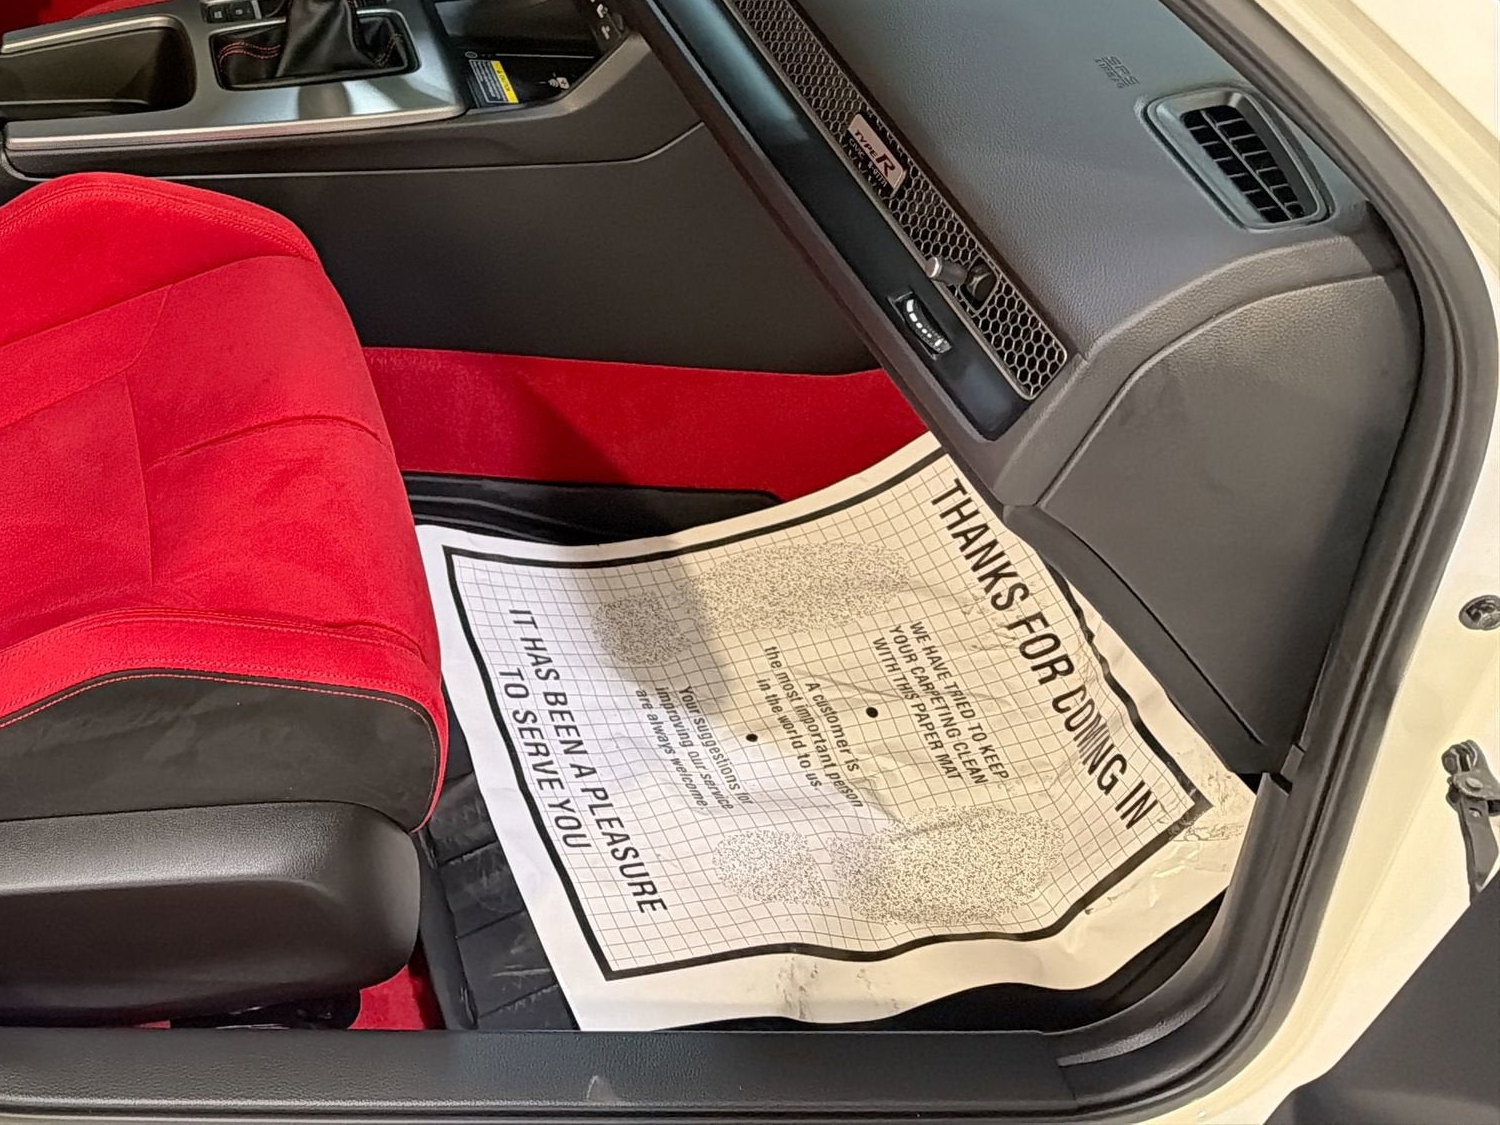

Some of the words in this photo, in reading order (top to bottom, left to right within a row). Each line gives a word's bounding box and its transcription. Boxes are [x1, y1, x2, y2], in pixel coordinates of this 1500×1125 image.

[849, 138, 866, 160] CIVIC
[854, 129, 877, 158] TYPE
[875, 153, 895, 178] R
[509, 609, 538, 629] IT
[498, 668, 529, 699] TO
[520, 637, 560, 681] HAS
[931, 478, 1030, 611] THANKS
[1005, 611, 1075, 685] FOR
[1052, 684, 1127, 796] COMING
[1115, 780, 1158, 830] IN
[805, 682, 821, 692] A
[872, 637, 900, 673] WITH
[893, 674, 920, 701] THIS
[911, 702, 944, 750] PAPER
[935, 753, 963, 780] MAT
[889, 625, 918, 664] YOUR
[910, 666, 961, 739] CARPETING
[952, 742, 988, 784] CLEAN
[910, 621, 931, 643] WE
[922, 645, 952, 681] HAVE
[944, 681, 976, 719] TRIED
[967, 722, 988, 742] TO
[978, 744, 1009, 780] KEEP
[512, 709, 565, 790] SERVE
[543, 691, 587, 755] BEEN
[635, 689, 653, 710] are
[647, 713, 676, 755] always
[655, 686, 694, 748] improving
[687, 751, 709, 771] our
[699, 773, 734, 810] service
[679, 685, 701, 714] Your
[693, 717, 741, 790] suggestions
[756, 678, 771, 692] in
[765, 693, 783, 714] the
[777, 715, 807, 749] world
[797, 753, 811, 769] to
[805, 772, 822, 791] us.
[764, 646, 782, 669] the
[776, 672, 804, 702] most
[795, 704, 837, 769] important
[825, 771, 863, 807] person
[812, 694, 852, 755] customer
[570, 763, 598, 778] A
[844, 757, 860, 772] is
[548, 798, 592, 848] YOU
[581, 787, 668, 914] PLEASURE
